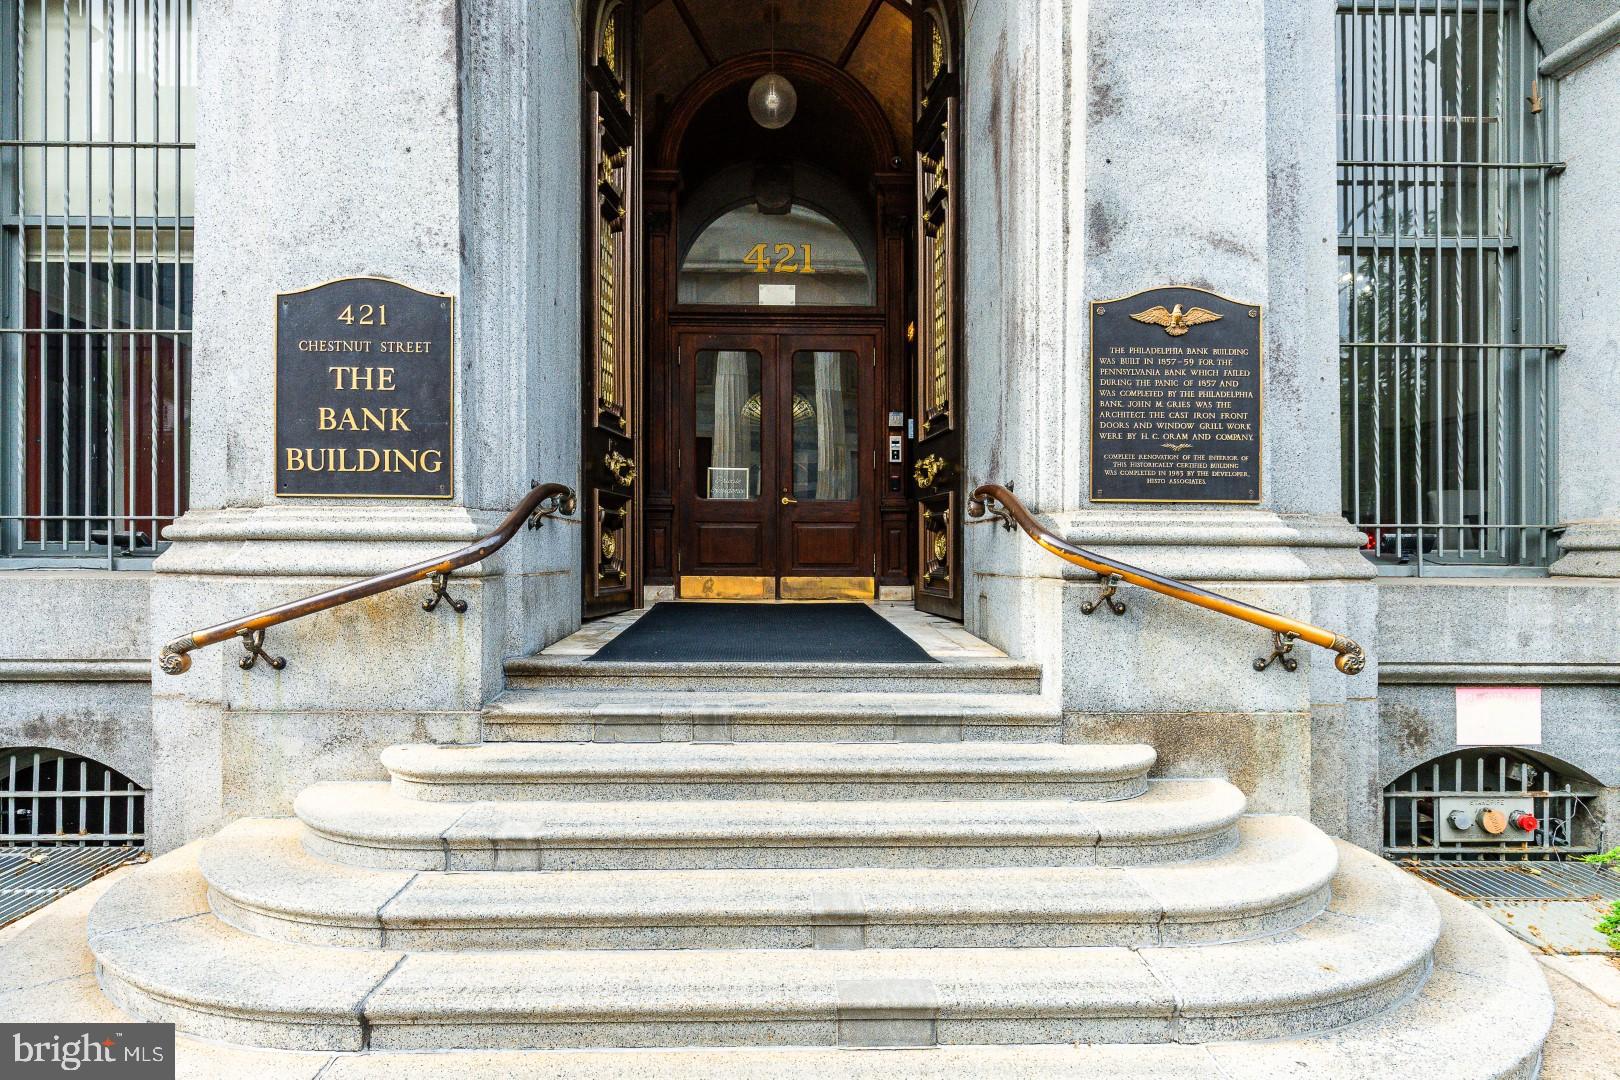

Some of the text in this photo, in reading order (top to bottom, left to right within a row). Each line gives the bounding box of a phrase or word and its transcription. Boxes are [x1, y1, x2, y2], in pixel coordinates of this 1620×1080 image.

[744, 243, 816, 273] 421
[337, 304, 388, 326] 421
[298, 340, 432, 353] CHESTNUT STREET
[328, 366, 396, 391] THE
[318, 407, 411, 432] BANK
[286, 448, 443, 472] BUILDING
